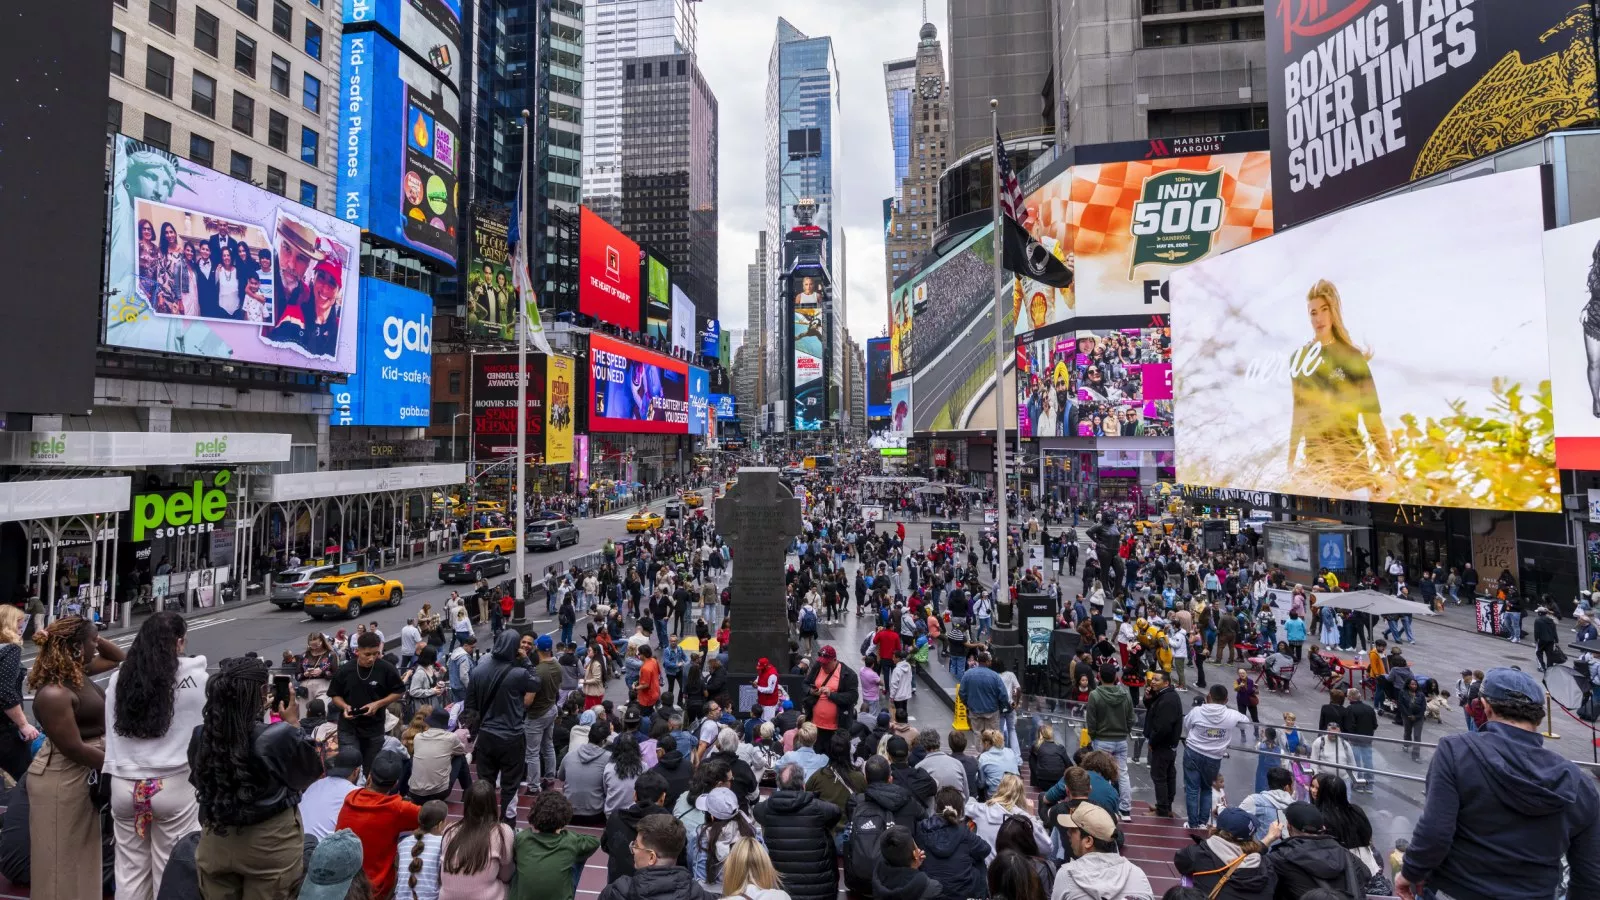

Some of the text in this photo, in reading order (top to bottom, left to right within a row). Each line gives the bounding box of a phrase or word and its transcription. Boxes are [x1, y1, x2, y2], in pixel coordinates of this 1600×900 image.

[1285, 4, 1390, 109] BOXING
[1287, 8, 1477, 150] OVER TIMES
[346, 38, 364, 222] Kid-safe Phones Kid
[1174, 135, 1226, 145] MARRIOTT
[1174, 144, 1221, 154] MARQUIS
[1288, 97, 1406, 193] SQUARE
[1157, 182, 1207, 200] INDY
[1133, 198, 1222, 235] 500
[383, 313, 433, 360] gab
[591, 348, 627, 370] THE SPEED
[382, 366, 421, 383] Kid-safe
[591, 364, 625, 384] YOU NEED
[652, 396, 663, 408] THE
[662, 398, 681, 412] BATTERY
[475, 416, 542, 434] STANGER
[31, 433, 66, 458] pelé
[195, 435, 228, 458] pelé
[1183, 484, 1238, 501] AMERICAN
[133, 469, 231, 542] pelé
[156, 523, 215, 539] SOCCER
